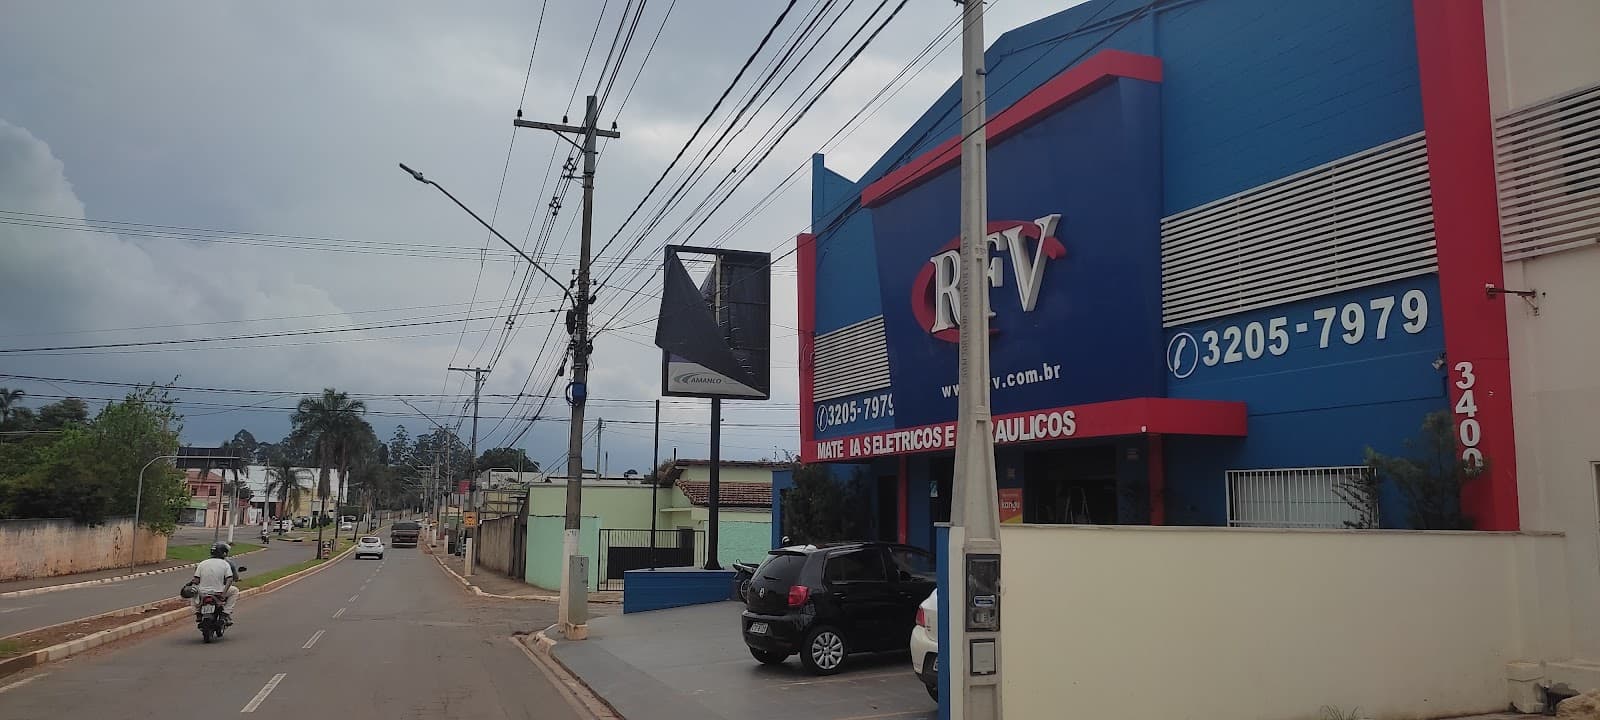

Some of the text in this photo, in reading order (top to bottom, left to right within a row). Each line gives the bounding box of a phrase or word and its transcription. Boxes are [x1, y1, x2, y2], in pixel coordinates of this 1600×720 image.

[1202, 289, 1429, 367] 3205-7979
[828, 393, 895, 426] 3205-7979
[872, 426, 942, 455] ELETRICOS
[945, 425, 955, 447] E
[991, 410, 1076, 443] AULICOS
[1454, 361, 1484, 477] 3400
